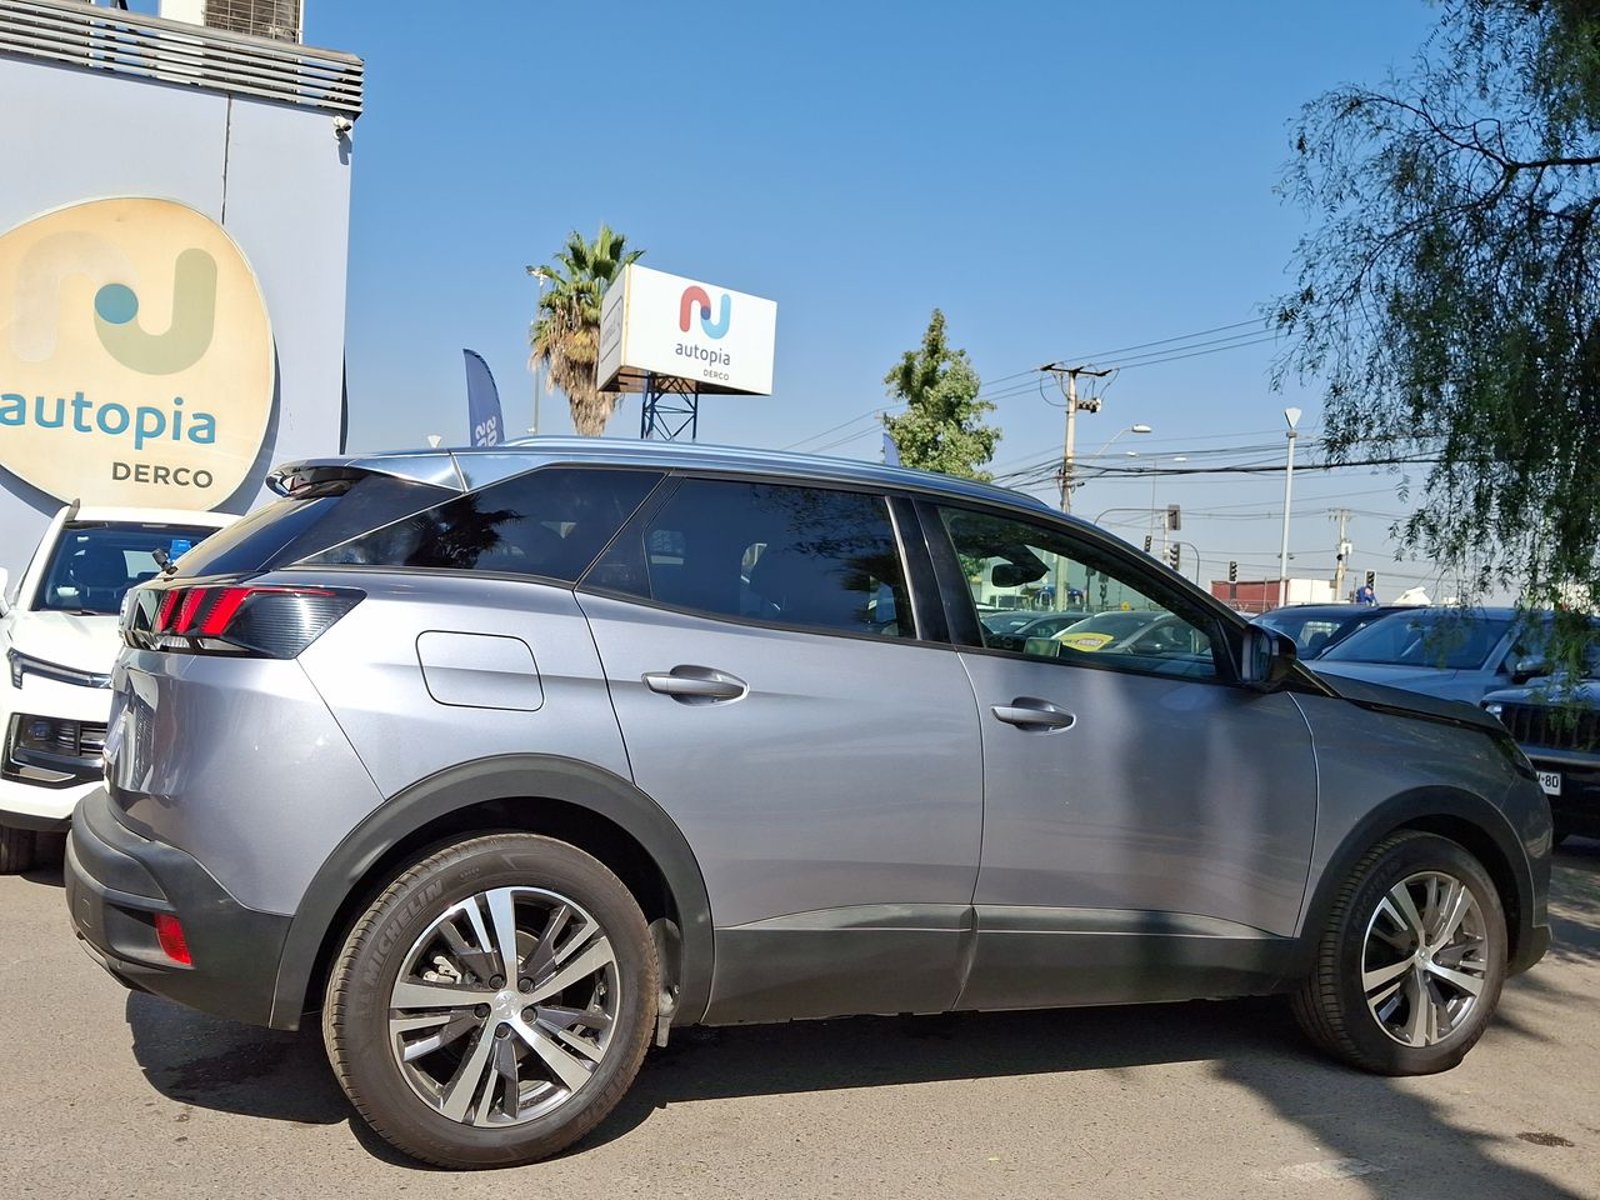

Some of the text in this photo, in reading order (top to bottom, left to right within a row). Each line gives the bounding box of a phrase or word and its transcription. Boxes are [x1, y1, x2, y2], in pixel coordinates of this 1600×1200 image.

[675, 343, 731, 367] autopia
[703, 369, 730, 381] DERCO
[0, 391, 216, 450] autopia
[112, 462, 213, 488] DERCO
[363, 879, 443, 983] MICHELIN
